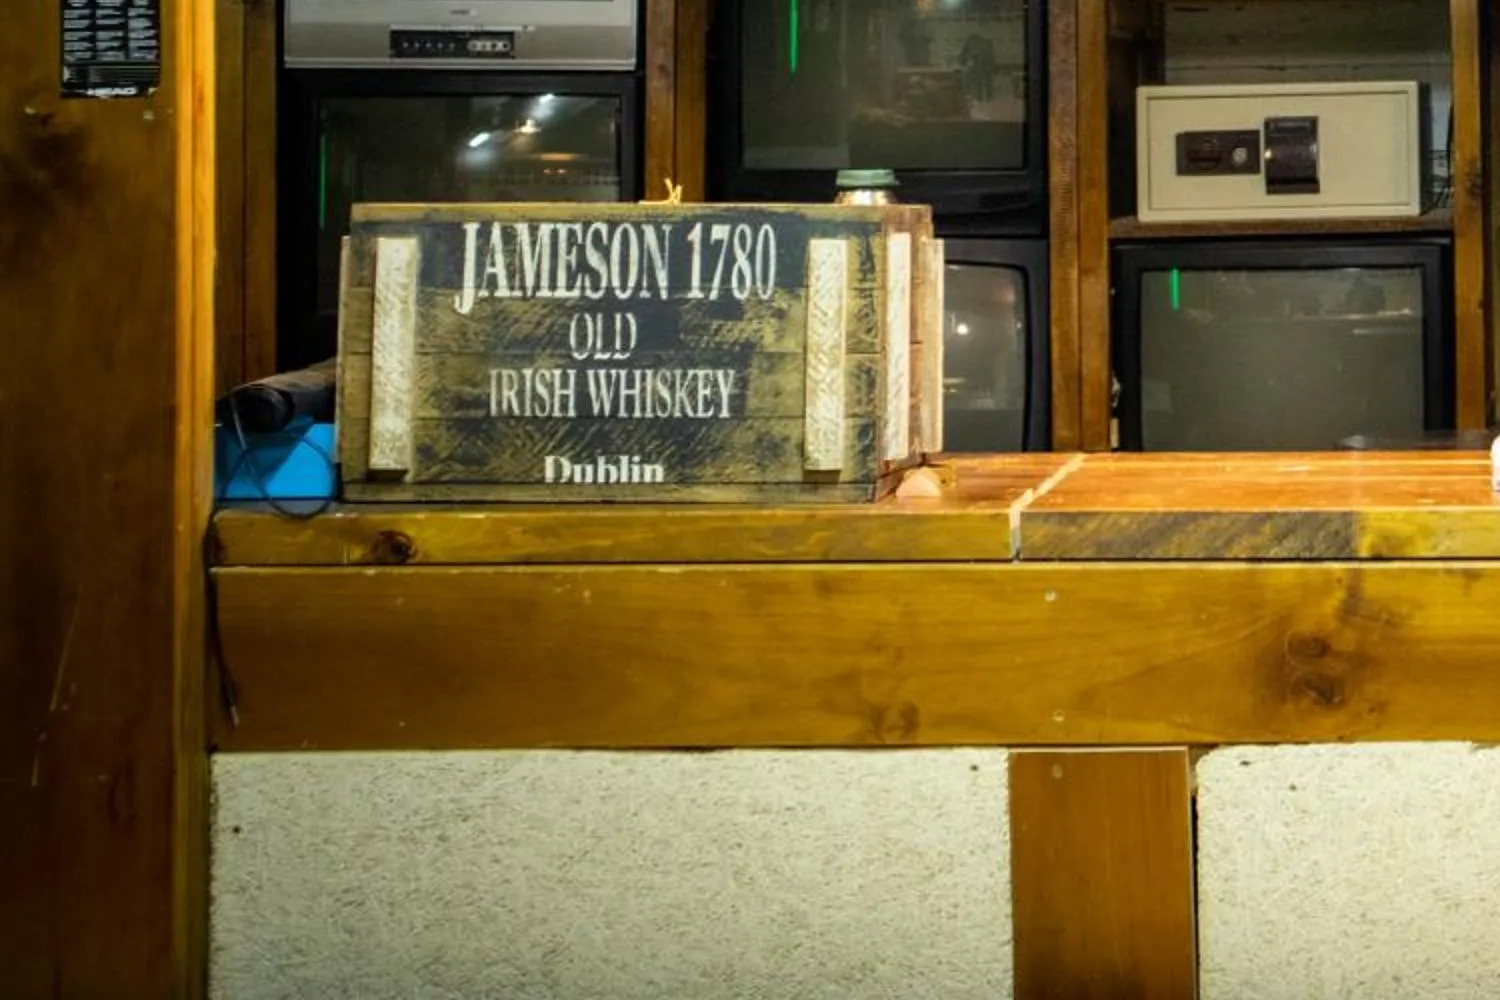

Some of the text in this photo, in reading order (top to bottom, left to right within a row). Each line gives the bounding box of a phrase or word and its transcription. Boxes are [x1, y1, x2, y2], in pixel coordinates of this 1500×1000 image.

[454, 221, 777, 315] JAMESON 1780
[569, 312, 637, 360] OLD
[490, 368, 736, 419] IRISH WHISKEY
[544, 454, 666, 484] Dublin
